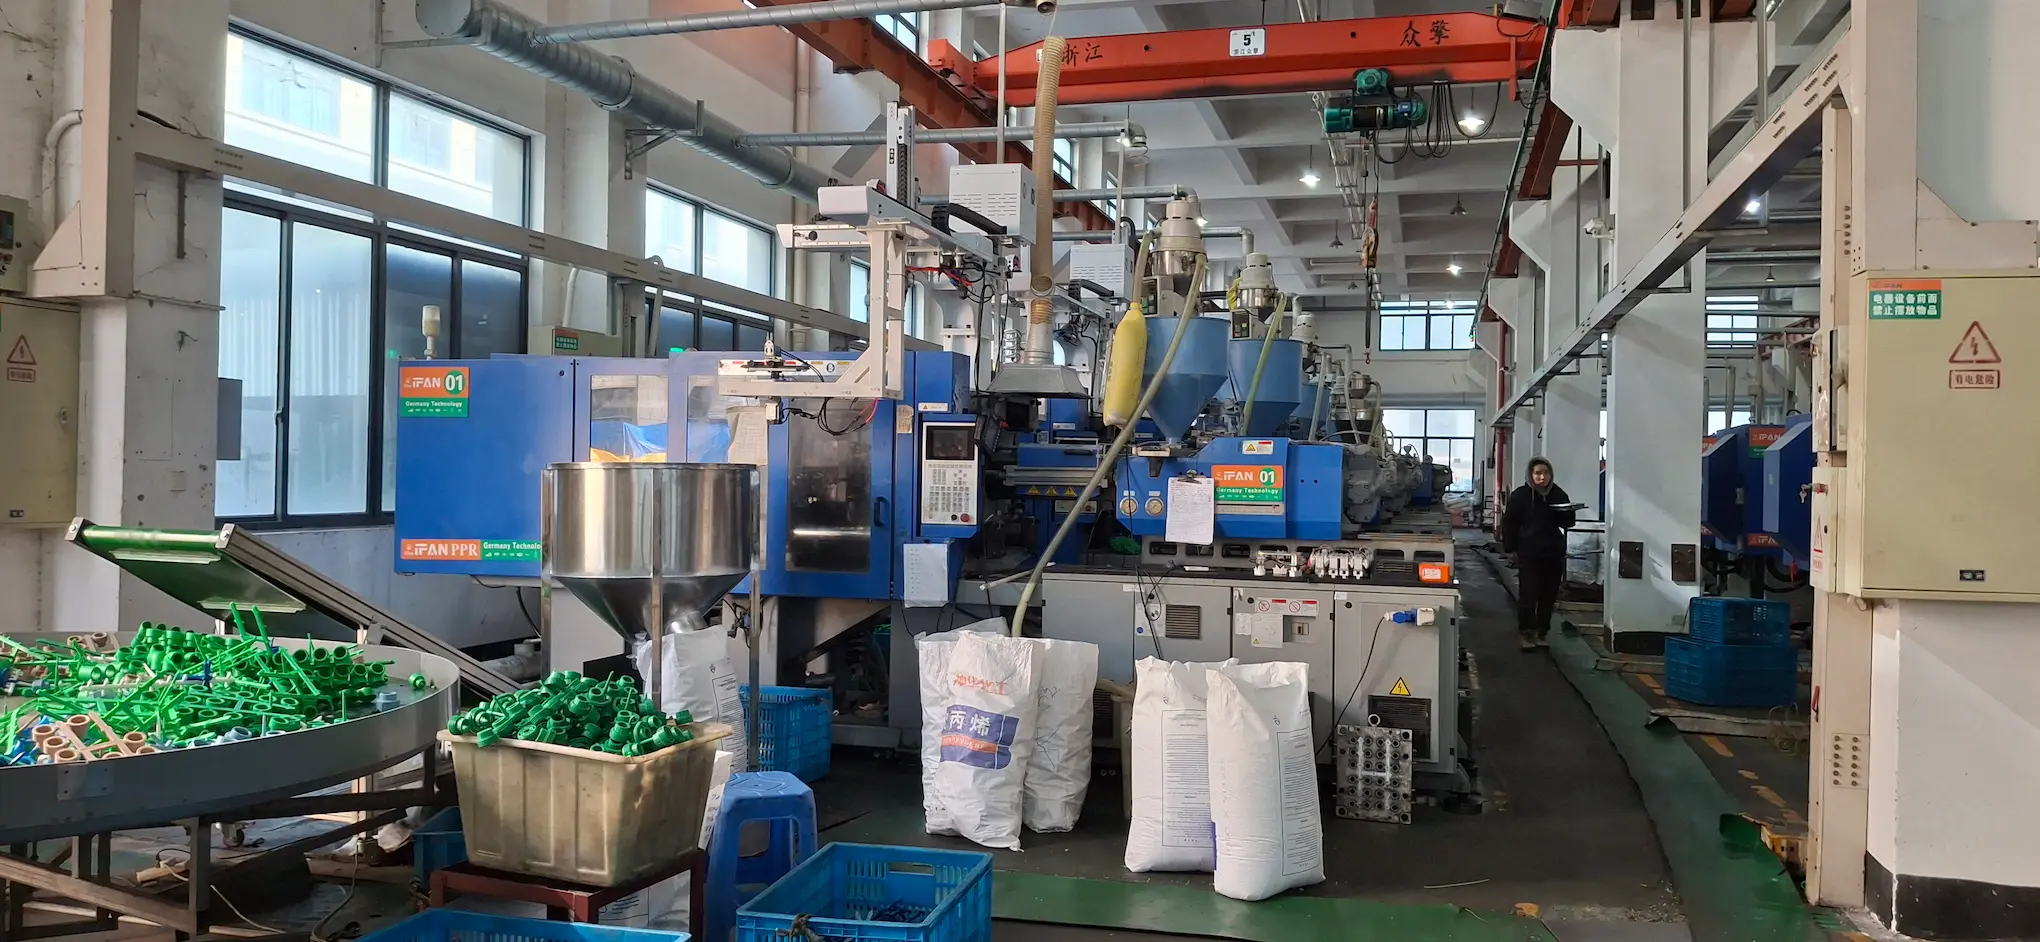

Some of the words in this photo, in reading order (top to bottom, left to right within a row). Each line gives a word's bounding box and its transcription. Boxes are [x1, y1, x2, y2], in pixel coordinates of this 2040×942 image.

[1400, 20, 1450, 46] 众擎
[1873, 293, 1938, 304] 电器设备前面
[445, 374, 463, 391] 01
[405, 400, 430, 408] Germany
[431, 400, 463, 408] Technology
[1260, 470, 1275, 483] 01
[1244, 487, 1279, 495] Technology
[451, 543, 478, 556] PPR
[483, 541, 510, 550] Germany
[512, 541, 541, 550] Technolo
[943, 710, 991, 737] 丙烯
